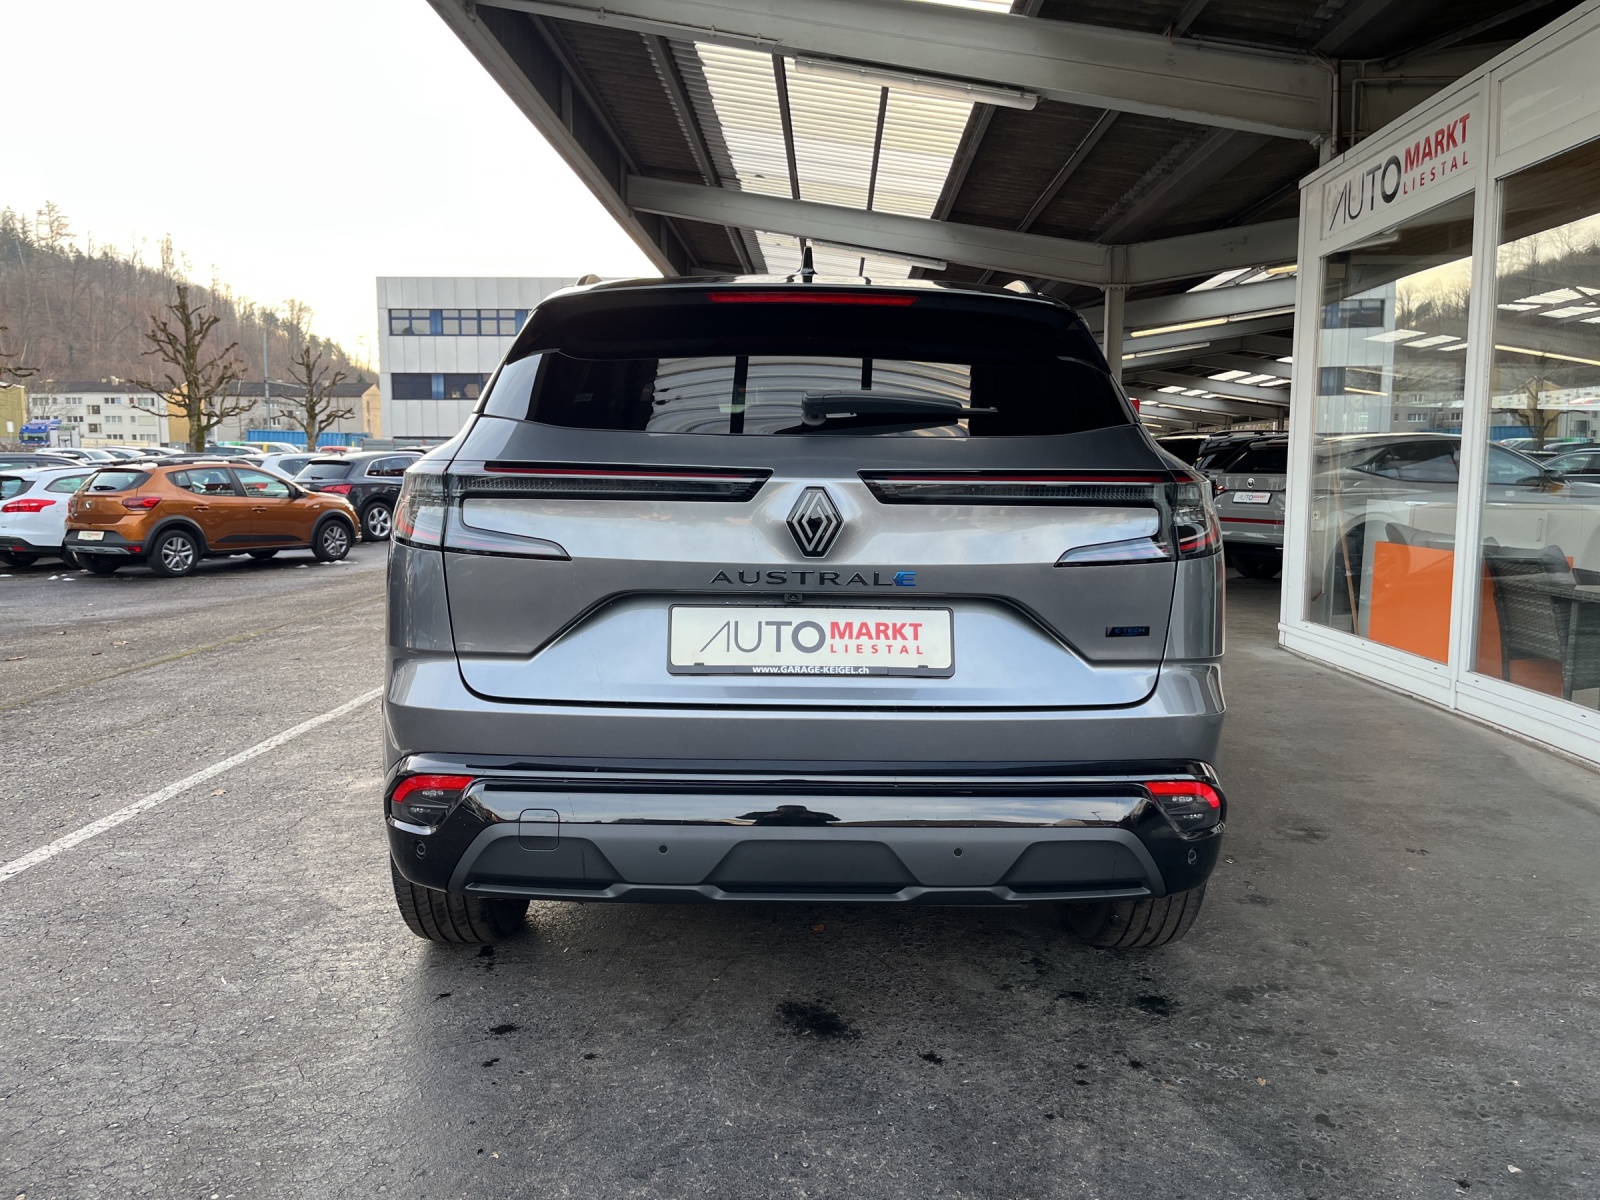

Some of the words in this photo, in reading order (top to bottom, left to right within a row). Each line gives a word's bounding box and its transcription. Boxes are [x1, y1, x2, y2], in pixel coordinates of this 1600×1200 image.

[1329, 155, 1401, 231] AUTO
[1404, 113, 1470, 174] MARKT
[1403, 151, 1468, 195] LIESTAL
[700, 620, 826, 654] AUTO
[830, 621, 922, 641] MARKT
[830, 643, 923, 655] LIESTAL
[752, 666, 869, 675] www.GARAGE-KEIGEL.ch
